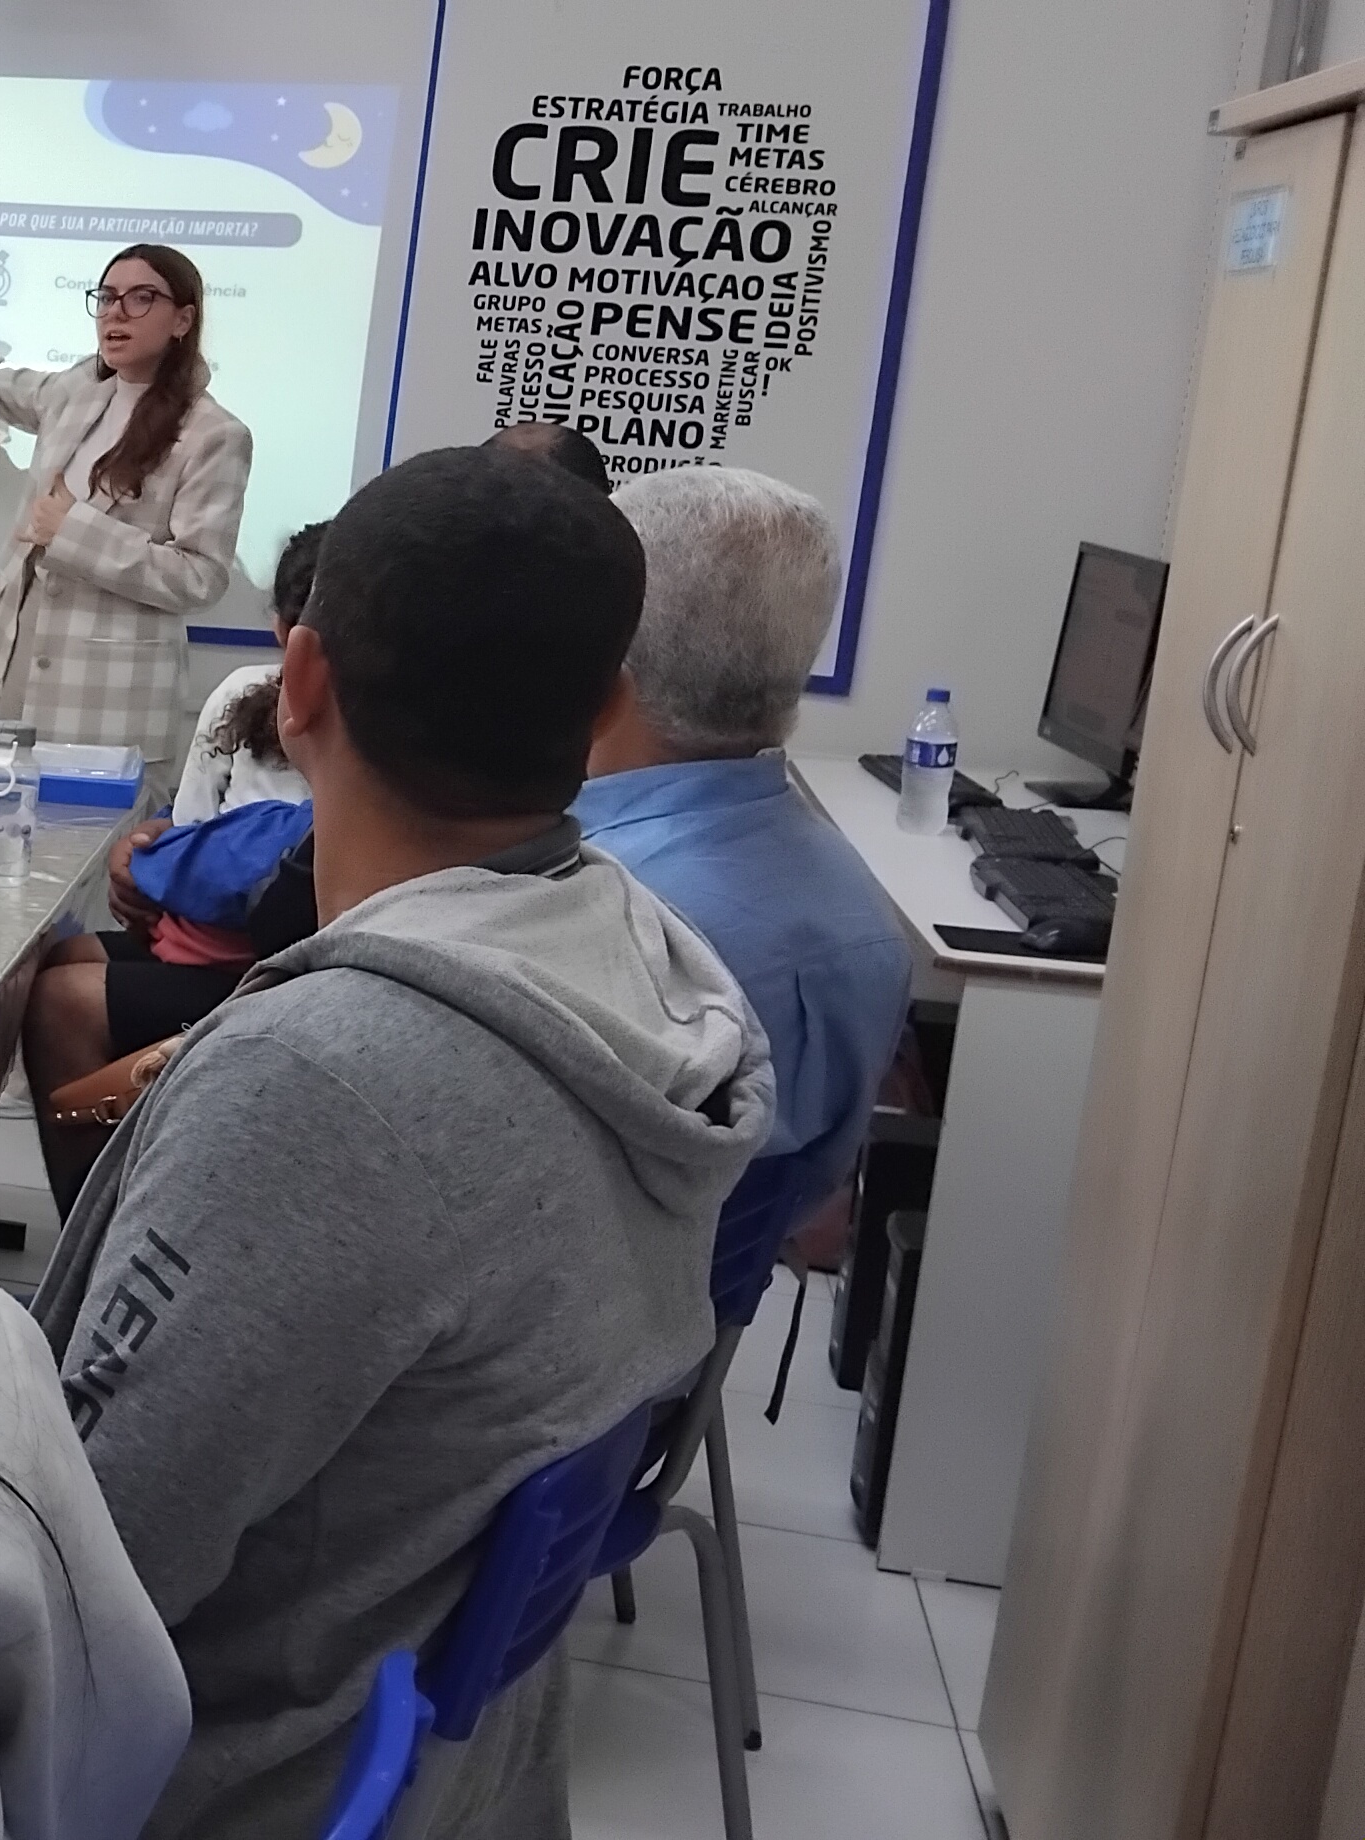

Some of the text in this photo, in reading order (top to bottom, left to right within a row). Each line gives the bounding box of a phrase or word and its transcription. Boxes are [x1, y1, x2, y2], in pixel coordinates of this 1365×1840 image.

[622, 65, 723, 96] FORÇA
[532, 95, 710, 124] ESTRATÉGIA
[718, 102, 812, 118] TRABALHO
[736, 123, 811, 144] TIME
[492, 122, 720, 208] CRIE
[728, 146, 826, 171] METAS
[724, 172, 836, 197] CÉREBRO
[748, 199, 838, 218] ALCANÇAR
[0, 212, 259, 238] POR QUE SUA PARTICIPAÇÃO IMPORTA?
[471, 205, 793, 268] INOVAÇÃO
[467, 260, 558, 289] ALVO
[794, 219, 832, 356] POSITIVISMO
[473, 294, 546, 313] GRUPO
[763, 271, 799, 350] IDEIA
[476, 316, 543, 334] METAS
[590, 301, 758, 345] PENSE
[476, 338, 499, 383] FALE
[592, 343, 710, 367] CONVERSA
[765, 356, 793, 372] OK
[494, 339, 521, 429] PALAVRAS
[517, 342, 547, 424] UCESSO
[584, 365, 710, 390] PROCESSO
[735, 351, 761, 426] BUSCAR
[579, 388, 705, 415] PESQUISA
[709, 349, 739, 449] MARKETING
[576, 414, 705, 450] PLANO
